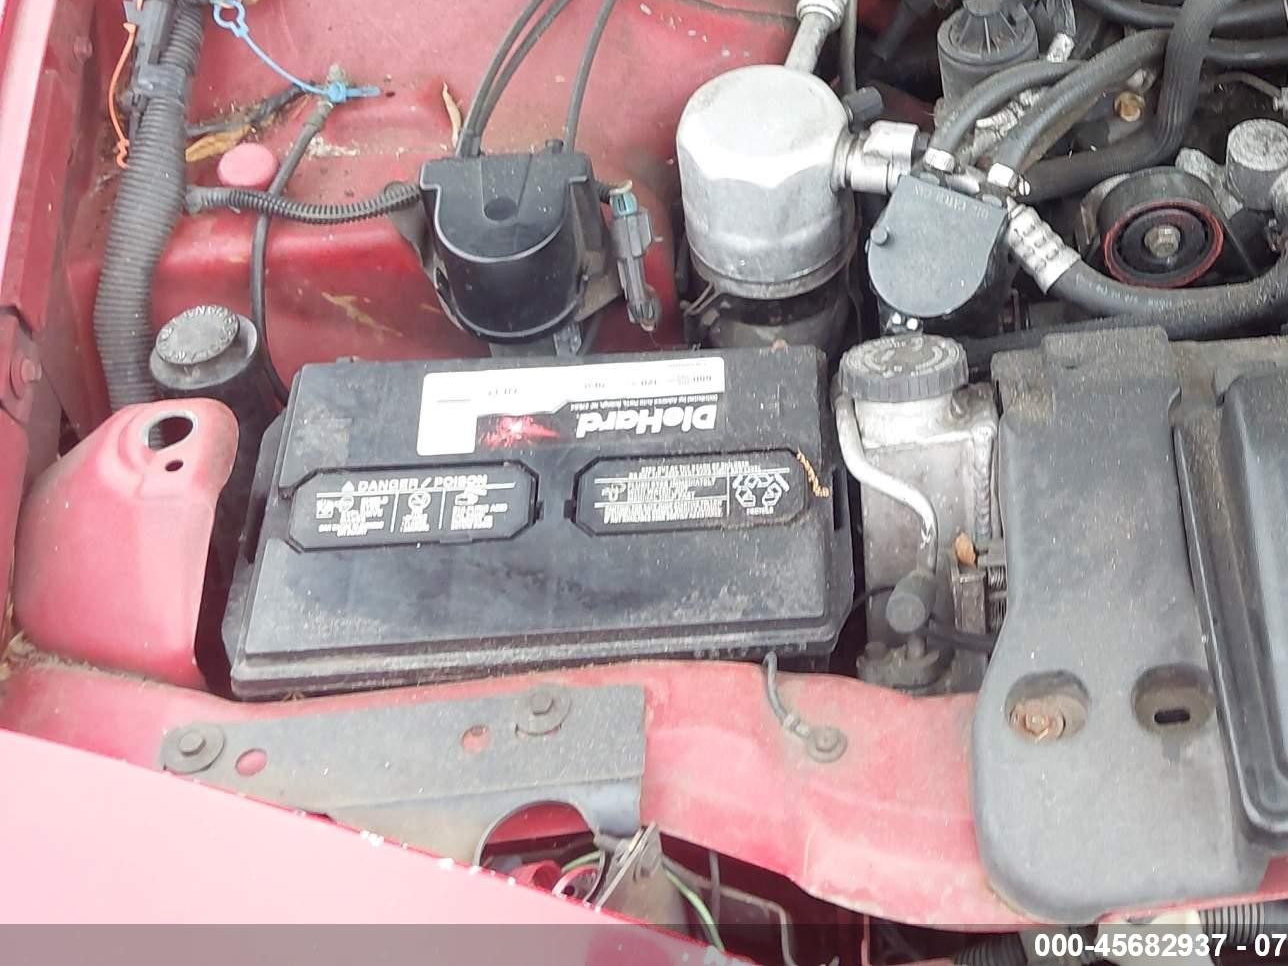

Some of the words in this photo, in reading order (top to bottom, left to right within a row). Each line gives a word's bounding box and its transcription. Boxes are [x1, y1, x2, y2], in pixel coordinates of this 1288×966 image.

[576, 404, 717, 438] DieHard
[358, 478, 419, 492] DANGER
[434, 474, 487, 489] POISON
